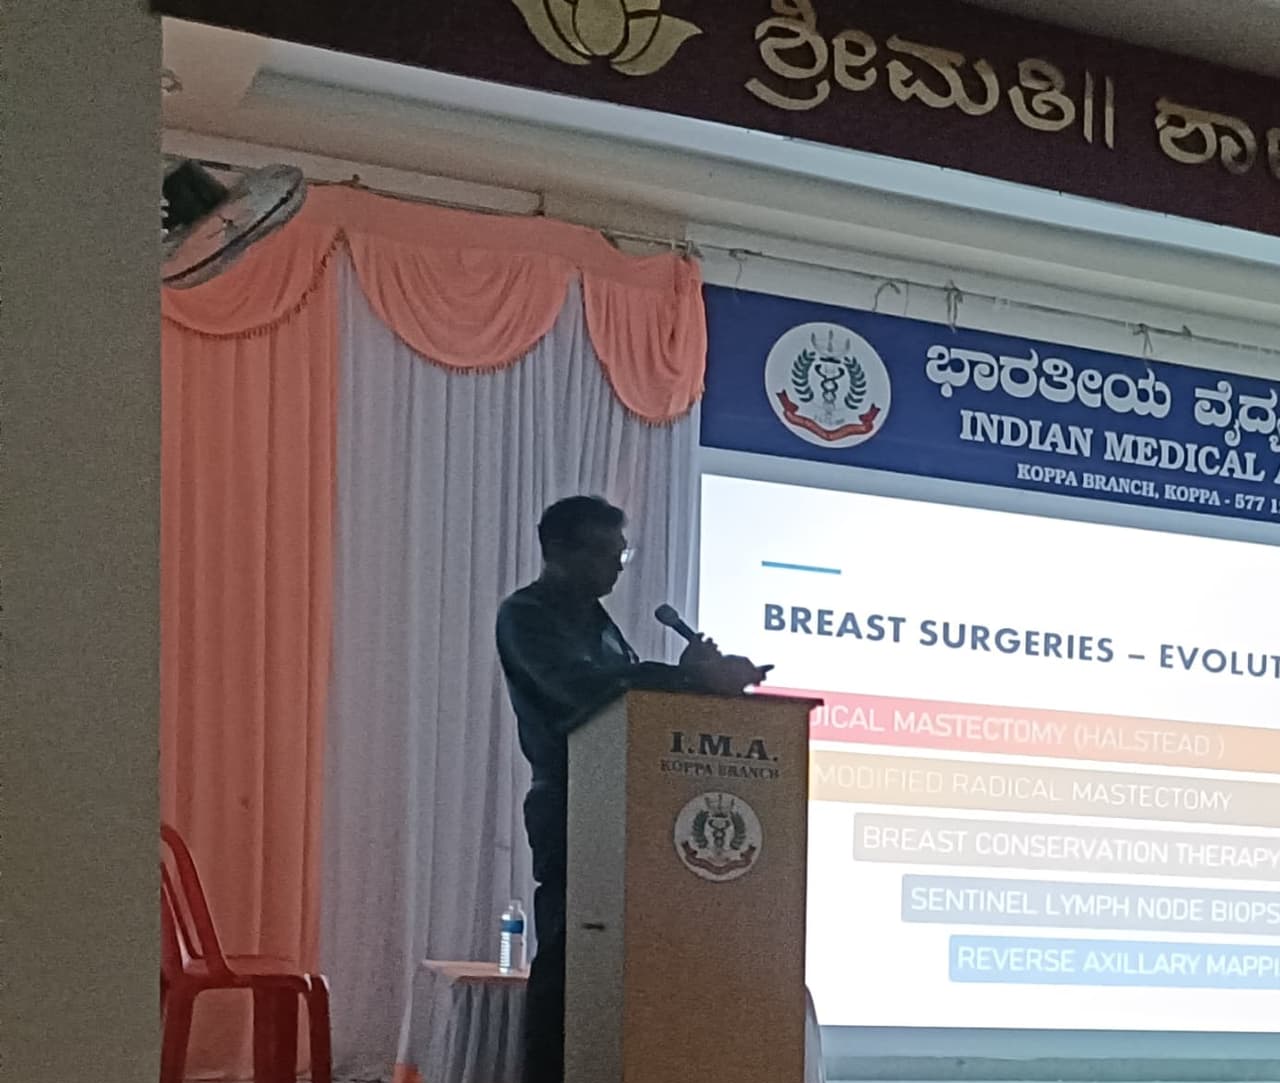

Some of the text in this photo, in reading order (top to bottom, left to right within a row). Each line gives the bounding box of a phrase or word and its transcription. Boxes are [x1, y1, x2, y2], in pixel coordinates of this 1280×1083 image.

[926, 344, 1171, 418] ಭಾರತೀಯ
[960, 409, 1093, 457] INDIAN
[1104, 431, 1265, 482] MEDICAL
[1017, 463, 1078, 487] KOPPA
[1082, 472, 1160, 499] BRANCH,
[1164, 483, 1221, 507] KOPPA
[1234, 494, 1265, 512] 577
[763, 602, 906, 644] BREAST
[919, 618, 1115, 664] SURGERIES
[809, 703, 884, 732] ICAL
[894, 710, 1066, 744] MASTECTOMY
[670, 731, 779, 762] I.M.A.
[660, 759, 713, 777] KOPPA
[814, 763, 1232, 810] MODIFIED RADICAL MASTECTOMY
[862, 825, 969, 854] BREAST
[975, 831, 1168, 865] CONSERVATION
[910, 886, 1038, 915] SENTINEL
[1046, 893, 1129, 918] LYMPH
[1137, 896, 1203, 921] NODE
[957, 945, 1075, 973] REVERSE
[1082, 951, 1200, 976] AXILLARY
